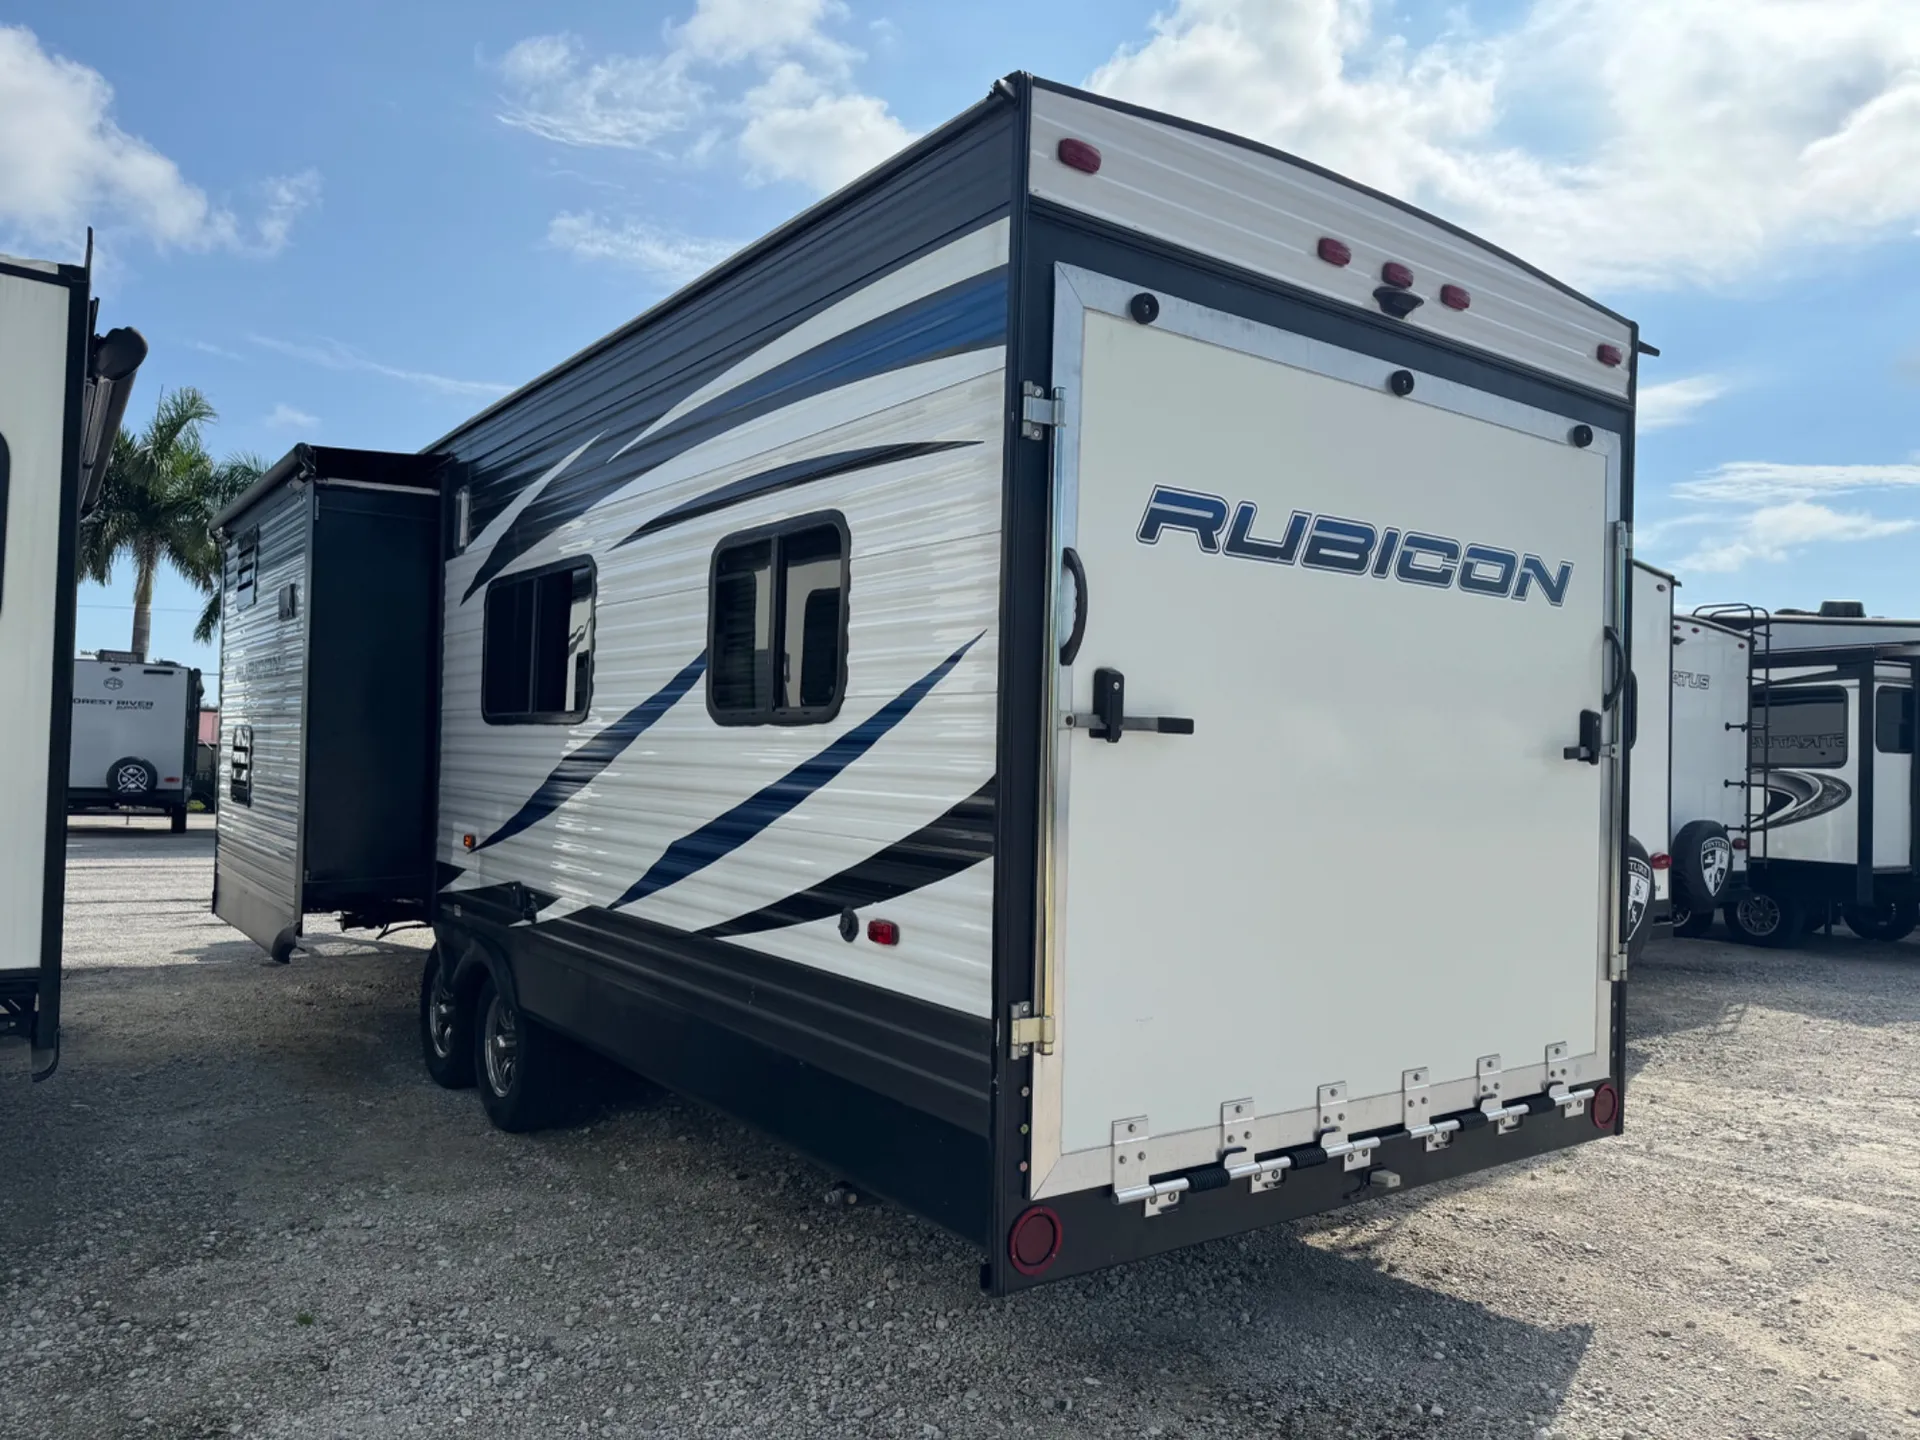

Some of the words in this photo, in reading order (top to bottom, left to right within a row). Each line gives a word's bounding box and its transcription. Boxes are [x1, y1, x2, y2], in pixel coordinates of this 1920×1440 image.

[1135, 483, 1575, 607] RUBICON
[1673, 670, 1710, 690] ATUS
[1628, 862, 1648, 877] TURE
